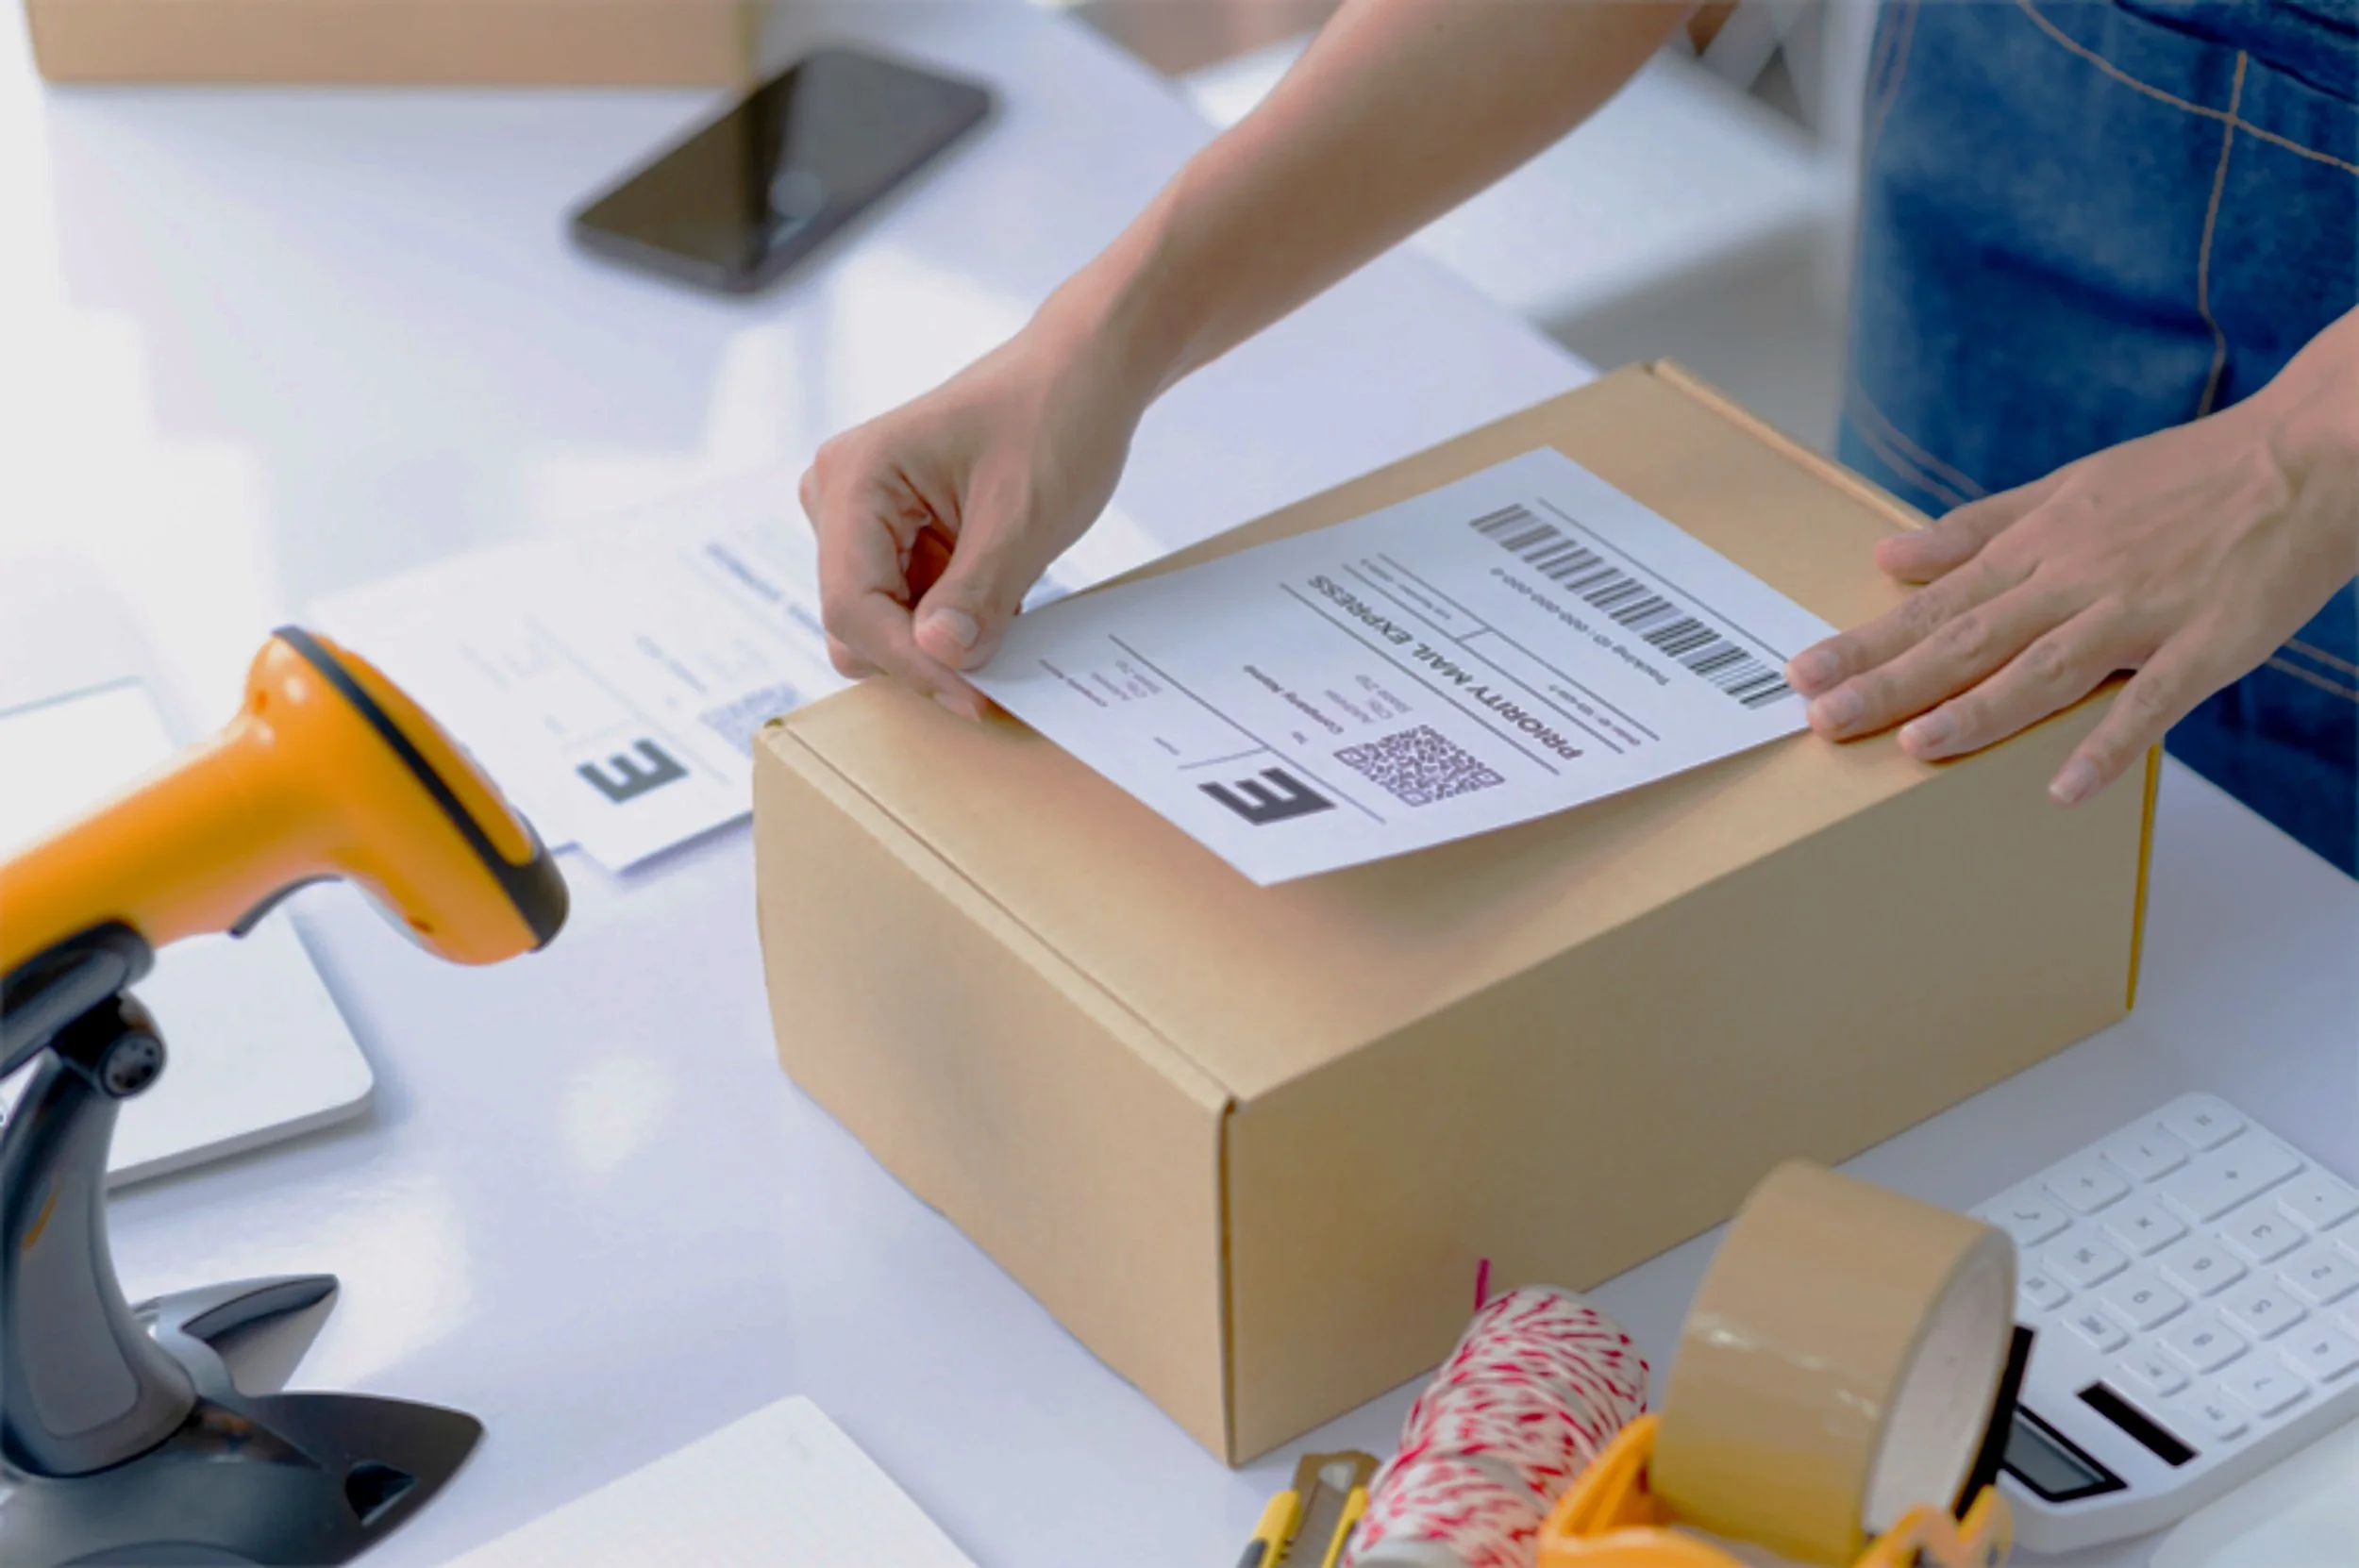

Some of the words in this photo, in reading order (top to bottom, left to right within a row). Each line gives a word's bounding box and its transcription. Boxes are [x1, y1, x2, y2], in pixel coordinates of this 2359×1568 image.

[1308, 575, 1414, 645] EXPRESS
[1243, 664, 1283, 693] Name
[1413, 642, 1473, 686] MAIL
[1283, 692, 1345, 735] Company
[1464, 685, 1583, 759] PRIORITY
[575, 737, 690, 805] E
[1196, 766, 1338, 826] E
